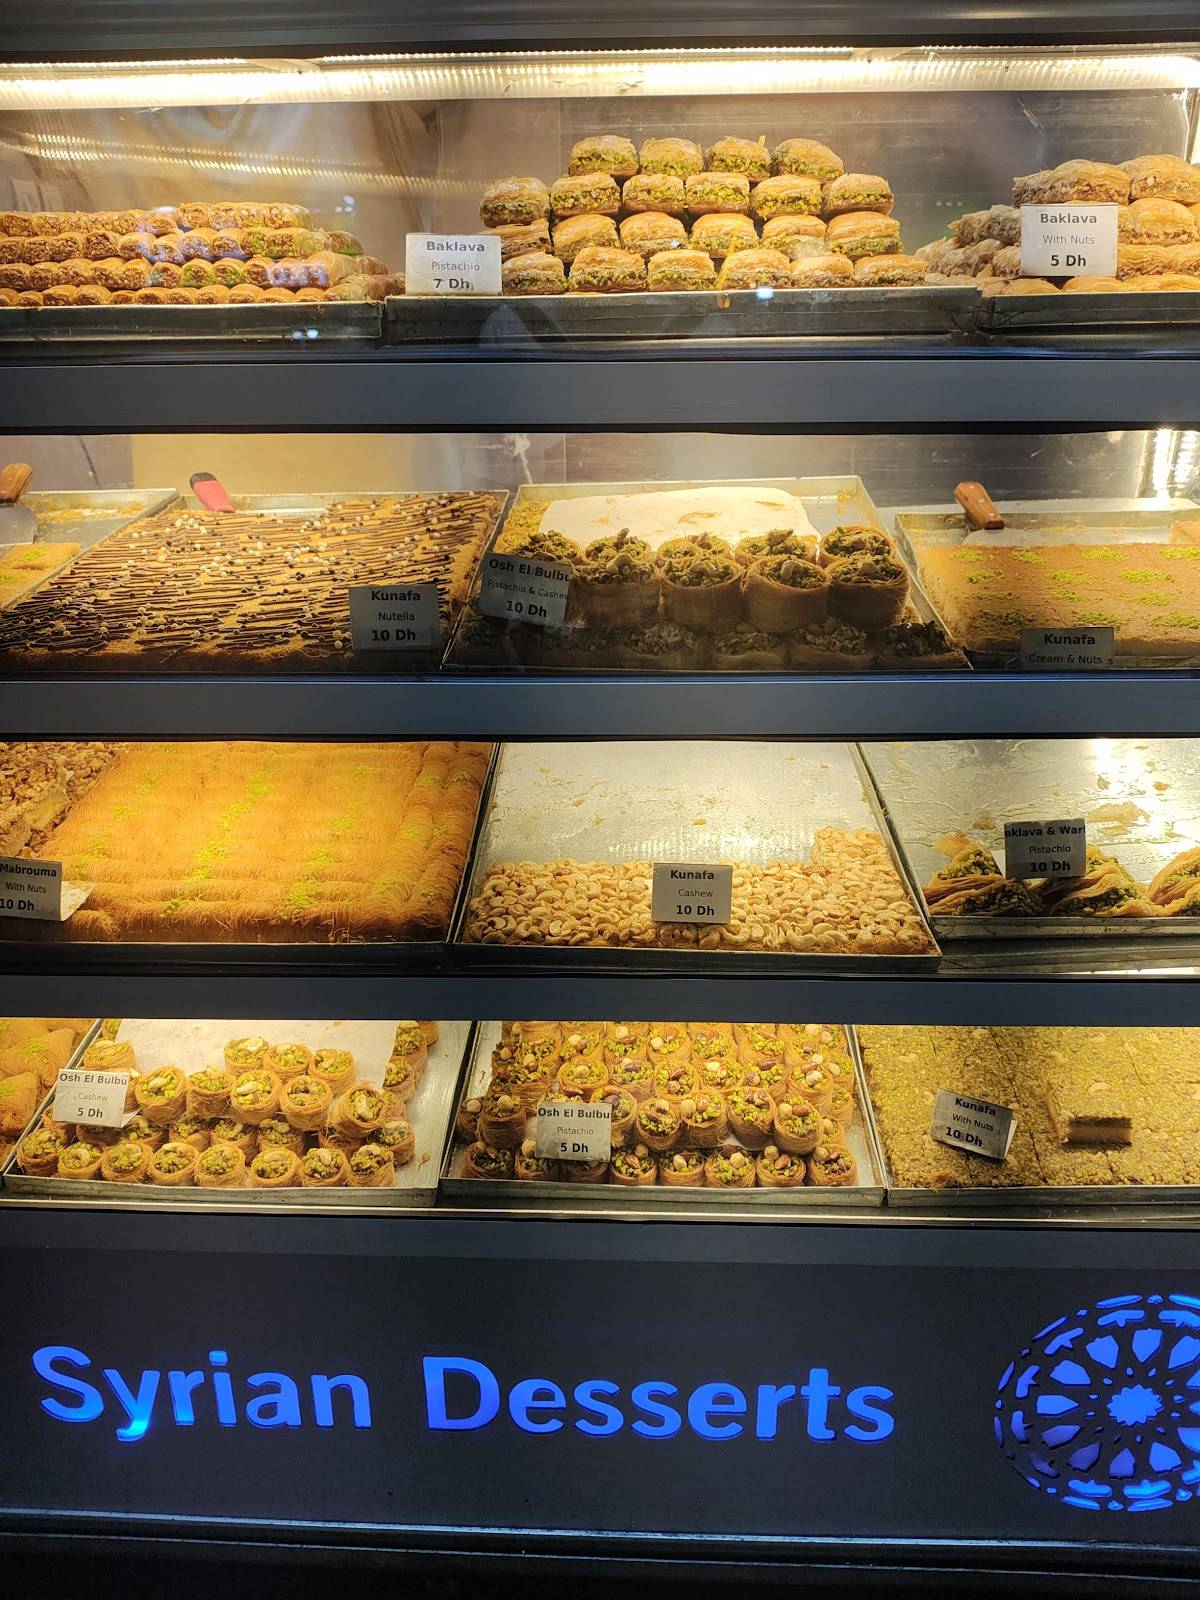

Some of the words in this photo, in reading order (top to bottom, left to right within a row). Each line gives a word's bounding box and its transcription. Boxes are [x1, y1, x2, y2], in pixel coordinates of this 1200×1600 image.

[1040, 213, 1097, 224] Baklava
[1042, 234, 1067, 244] With
[1071, 235, 1095, 245] Nuts
[426, 241, 485, 252] Baklava
[431, 261, 480, 271] Pistachio
[1051, 255, 1060, 266] 5
[1066, 254, 1086, 267] Dh
[433, 278, 444, 289] 7
[449, 278, 470, 289] Dh
[489, 559, 514, 571] Osh
[519, 564, 531, 575] El
[487, 578, 526, 593] Pistachio
[528, 586, 535, 595] &
[371, 590, 421, 601] Kunafa
[505, 600, 523, 613] 10
[528, 604, 547, 618] Dh
[378, 612, 415, 621] Nutella
[371, 630, 390, 641] 10
[395, 629, 416, 641] Dh
[1044, 633, 1096, 645] Kunafa
[1029, 653, 1063, 663] Cream
[1067, 654, 1075, 663] &
[1078, 655, 1104, 664] Nuts
[1047, 826, 1056, 836] &
[1029, 845, 1071, 854] Pistachio
[0, 863, 57, 877] Mabrouma
[1030, 862, 1047, 872] 10
[1052, 861, 1071, 872] Dh
[670, 869, 715, 880] Kunafa
[6, 882, 25, 892] With
[27, 884, 47, 894] Nuts
[678, 889, 714, 898] Cashew
[0, 899, 14, 910] 10
[18, 899, 35, 911] Dh
[676, 904, 692, 915] 10
[697, 905, 715, 916] Dh
[59, 1073, 80, 1082] Osh
[84, 1074, 94, 1083] El
[97, 1075, 128, 1085] Bulbu
[77, 1107, 84, 1117] 5
[88, 1108, 103, 1118] Dh
[954, 1097, 996, 1117] Kunafa
[538, 1107, 560, 1117] Osh
[563, 1108, 574, 1118] El
[577, 1109, 610, 1119] Bulbu
[952, 1113, 972, 1126] With
[974, 1119, 994, 1132] Nuts
[556, 1126, 594, 1135] Pistachio
[945, 1126, 961, 1139] 10
[965, 1133, 983, 1147] Dh
[560, 1142, 568, 1152] 5
[572, 1143, 589, 1153] Dh
[32, 1345, 371, 1442] Syrian
[422, 1356, 895, 1443] Desserts
